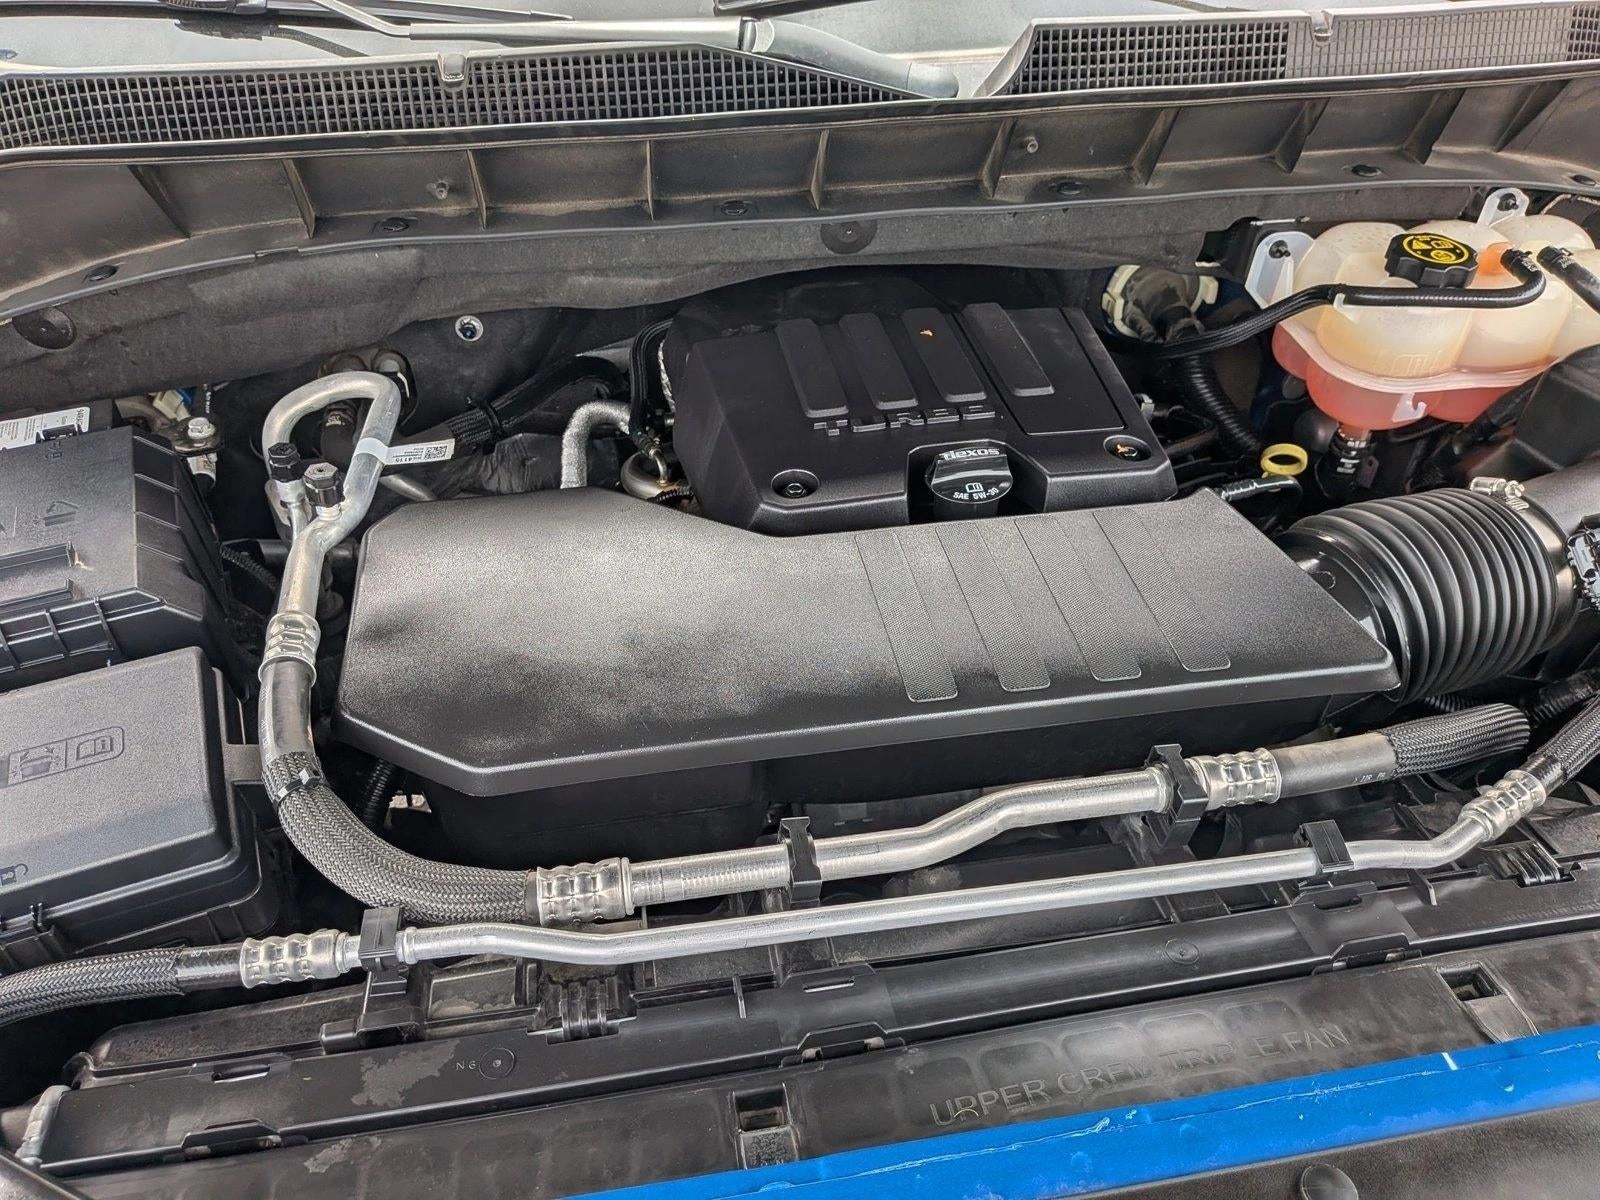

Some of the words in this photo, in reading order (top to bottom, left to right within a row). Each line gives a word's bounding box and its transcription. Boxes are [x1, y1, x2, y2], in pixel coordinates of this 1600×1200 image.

[941, 448, 1000, 461] dexos
[952, 491, 969, 500] SAE
[928, 1079, 1053, 1127] UPPER
[1281, 1024, 1352, 1054] FAN
